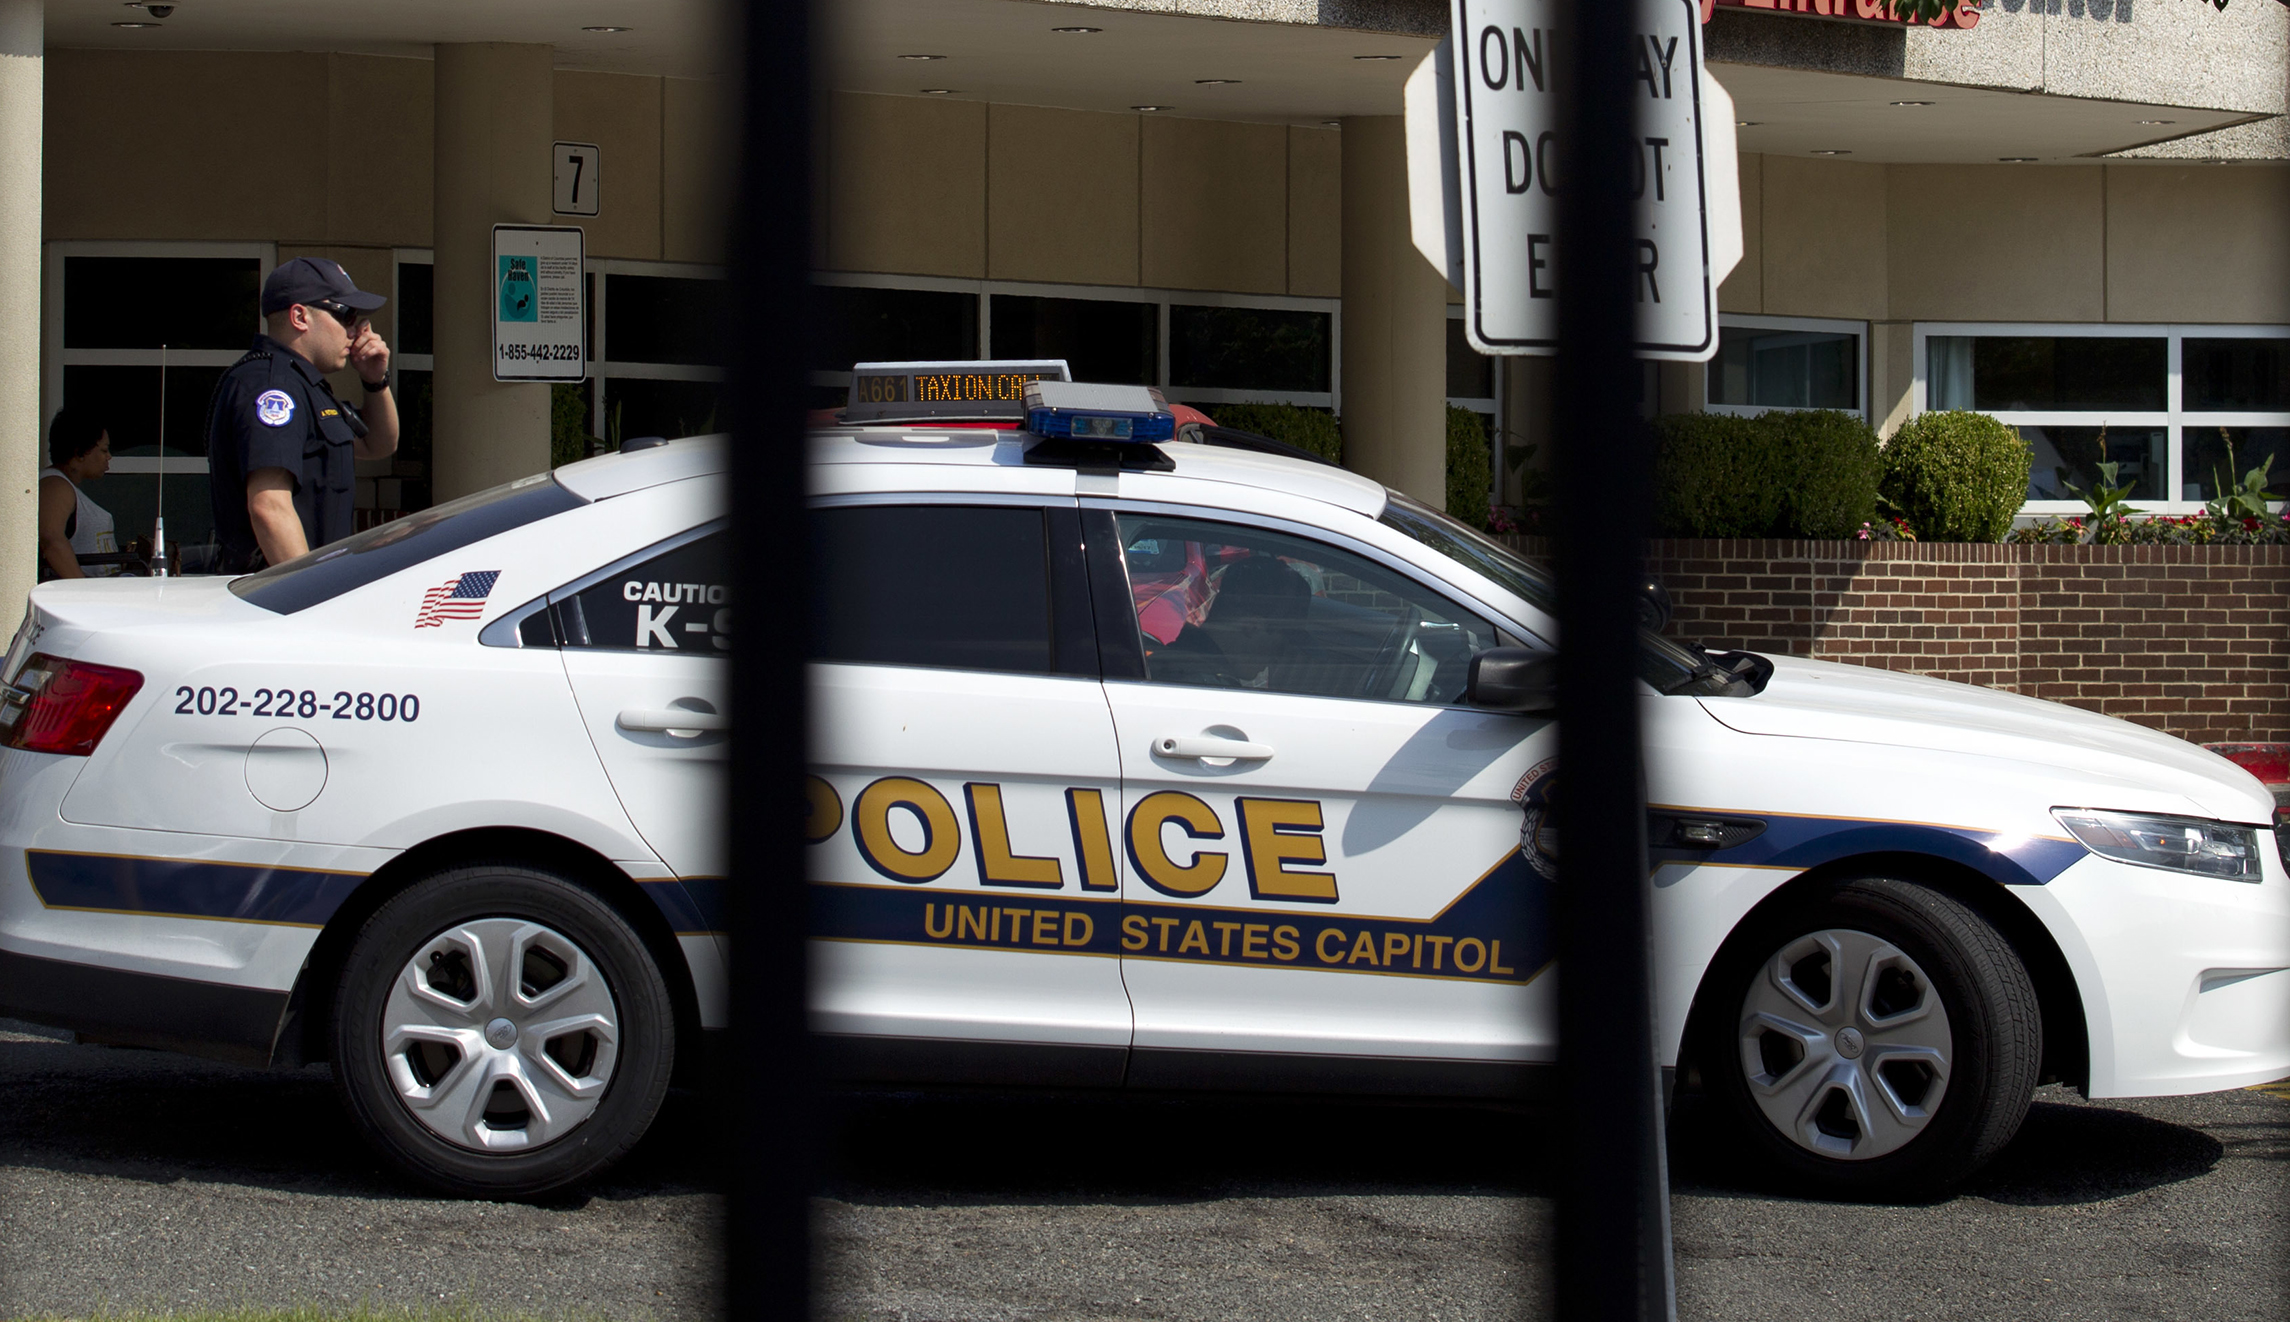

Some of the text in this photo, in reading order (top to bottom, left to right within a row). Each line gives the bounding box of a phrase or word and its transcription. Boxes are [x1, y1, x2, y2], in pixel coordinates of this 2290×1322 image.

[1480, 25, 1558, 94] ON
[568, 155, 584, 204] 7
[507, 269, 530, 283] Haven
[509, 257, 527, 271] Safe
[499, 343, 580, 361] 1-855-442-2229
[623, 580, 730, 605] CAUTIO
[174, 685, 420, 723] 202-228-2800
[1512, 769, 1540, 800] UNITED
[923, 902, 1516, 976] UNITED STATES CAPITOL
